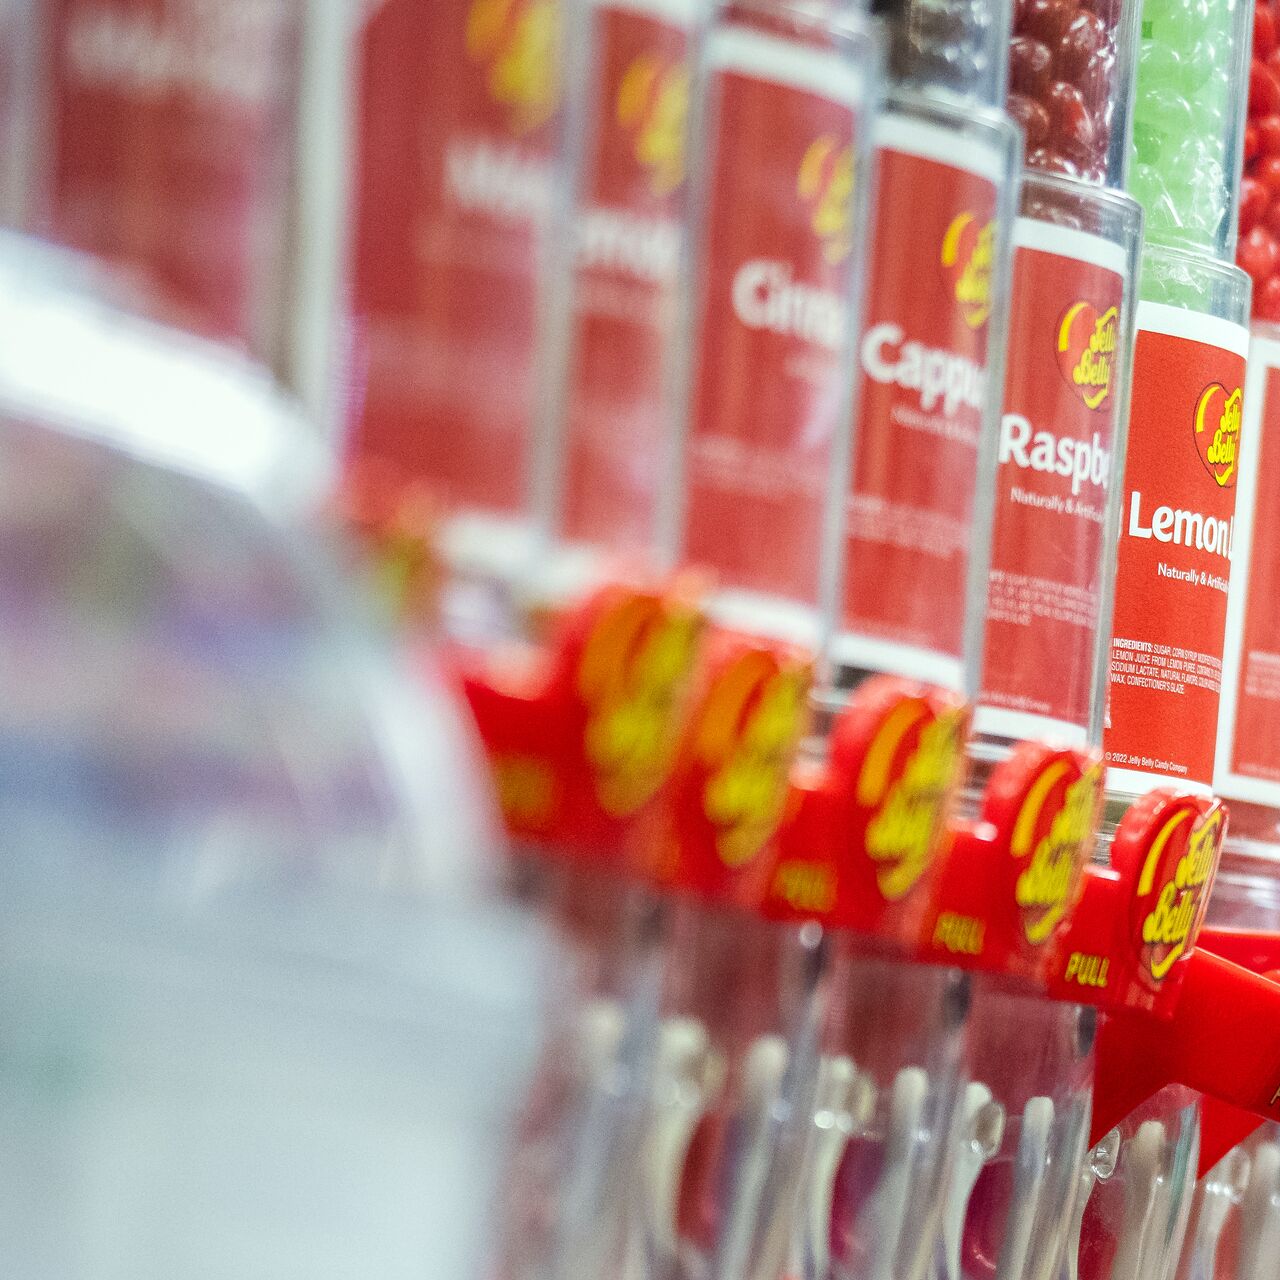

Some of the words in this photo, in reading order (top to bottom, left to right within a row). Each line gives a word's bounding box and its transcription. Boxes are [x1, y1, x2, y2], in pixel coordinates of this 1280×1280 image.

[1207, 429, 1236, 486] Belly
[1157, 562, 1199, 587] Naturally
[1200, 571, 1206, 586] &
[1112, 649, 1134, 661] LEMON
[1135, 653, 1151, 664] JUICE
[1151, 655, 1166, 667] FROM
[1167, 659, 1183, 670] LEMON
[1113, 637, 1153, 653] INGREDIENTS:
[1153, 644, 1172, 658] SUGAR,
[1111, 661, 1136, 674] SODIUM
[1136, 665, 1160, 679] LACTATE,
[1160, 669, 1181, 682] NATURAL
[1112, 752, 1127, 763] 2022
[1128, 755, 1141, 767] Jelly
[1141, 756, 1154, 768] Belly
[1154, 759, 1170, 771] Candy
[1170, 762, 1188, 775] Company
[1175, 808, 1222, 890] Jelly
[1142, 880, 1196, 978] Belly
[1065, 951, 1110, 988] PULL
